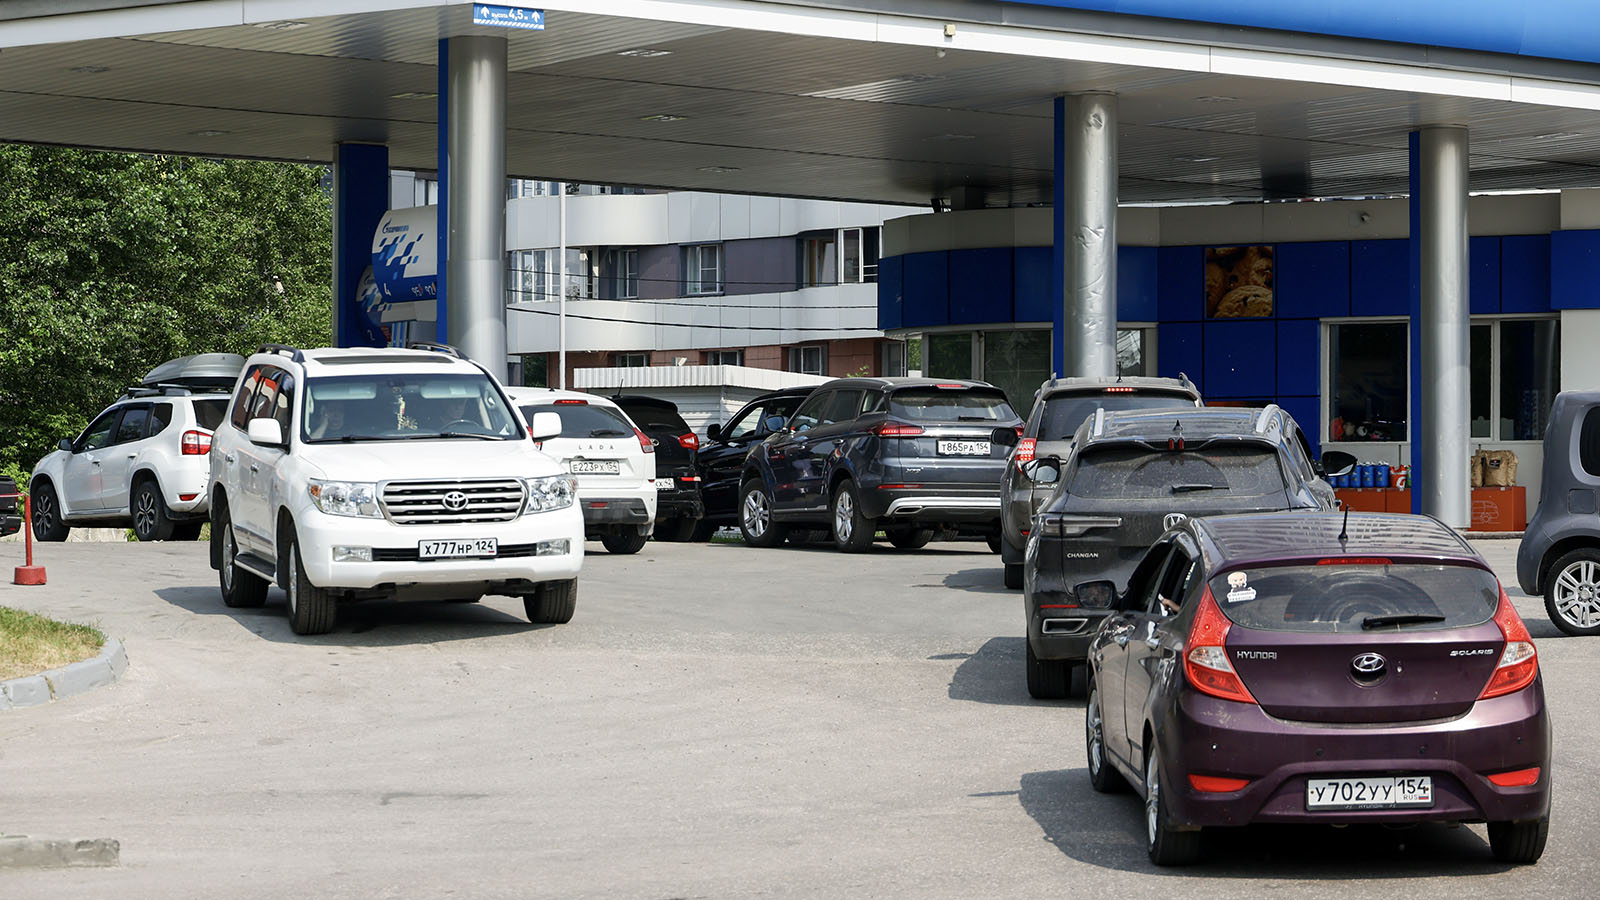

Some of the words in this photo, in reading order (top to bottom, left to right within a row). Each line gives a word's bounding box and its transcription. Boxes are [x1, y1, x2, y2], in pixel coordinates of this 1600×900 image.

[508, 8, 524, 21] 4,5
[383, 283, 392, 296] 4
[941, 442, 974, 452] Т865РА
[976, 442, 989, 450] 154
[605, 461, 618, 470] 154
[425, 541, 473, 555] Х777НР
[475, 540, 494, 551] 124
[1236, 650, 1278, 660] HYUNDAI
[1449, 648, 1494, 657] SOLARIS
[1315, 781, 1393, 802] У702УУ
[1397, 778, 1427, 795] 154
